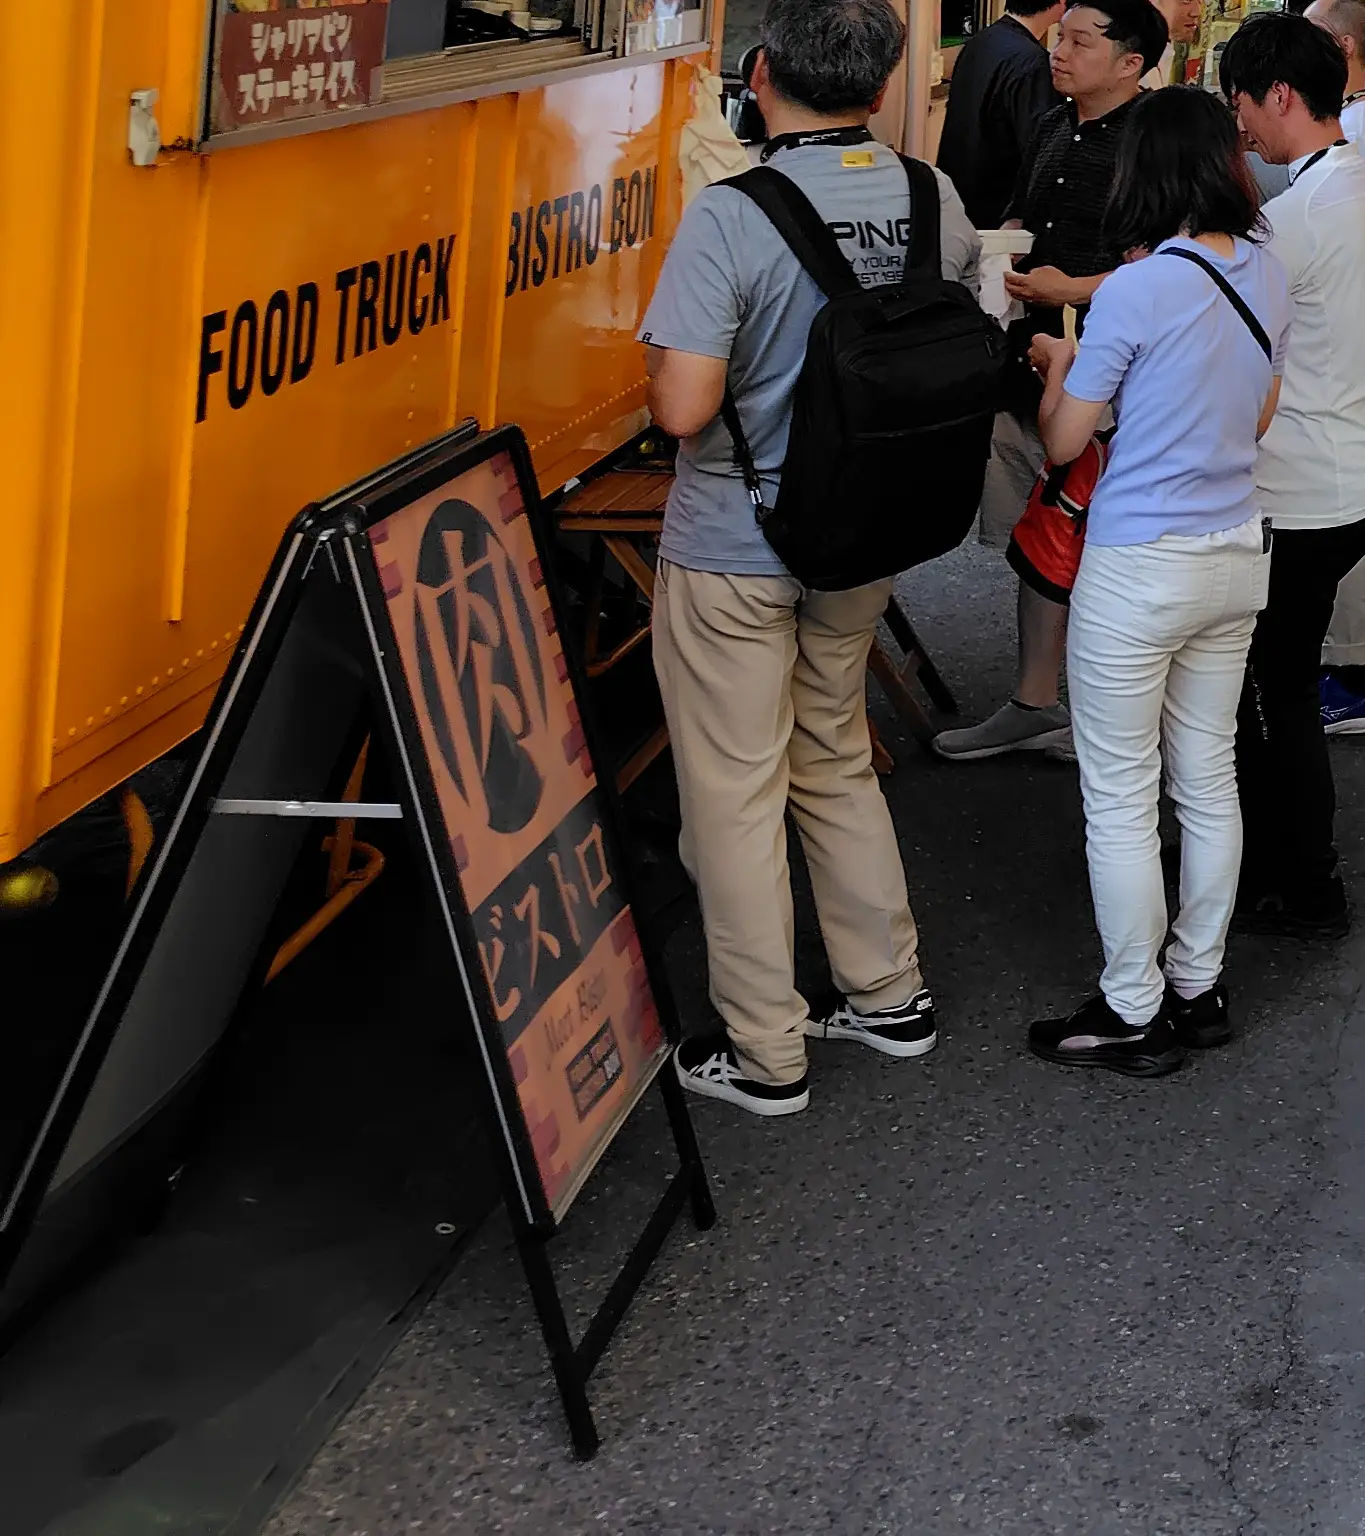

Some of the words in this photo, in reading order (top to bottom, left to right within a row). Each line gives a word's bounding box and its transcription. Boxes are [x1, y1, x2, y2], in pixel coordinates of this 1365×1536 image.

[238, 60, 357, 115] ステーキライス
[504, 183, 602, 299] BISTRO
[827, 218, 911, 249] PING
[860, 255, 901, 269] YOUR
[194, 280, 320, 424] FOOD
[335, 234, 457, 366] TRUCK
[415, 522, 546, 829] 肉
[478, 822, 612, 1022] ビストロ
